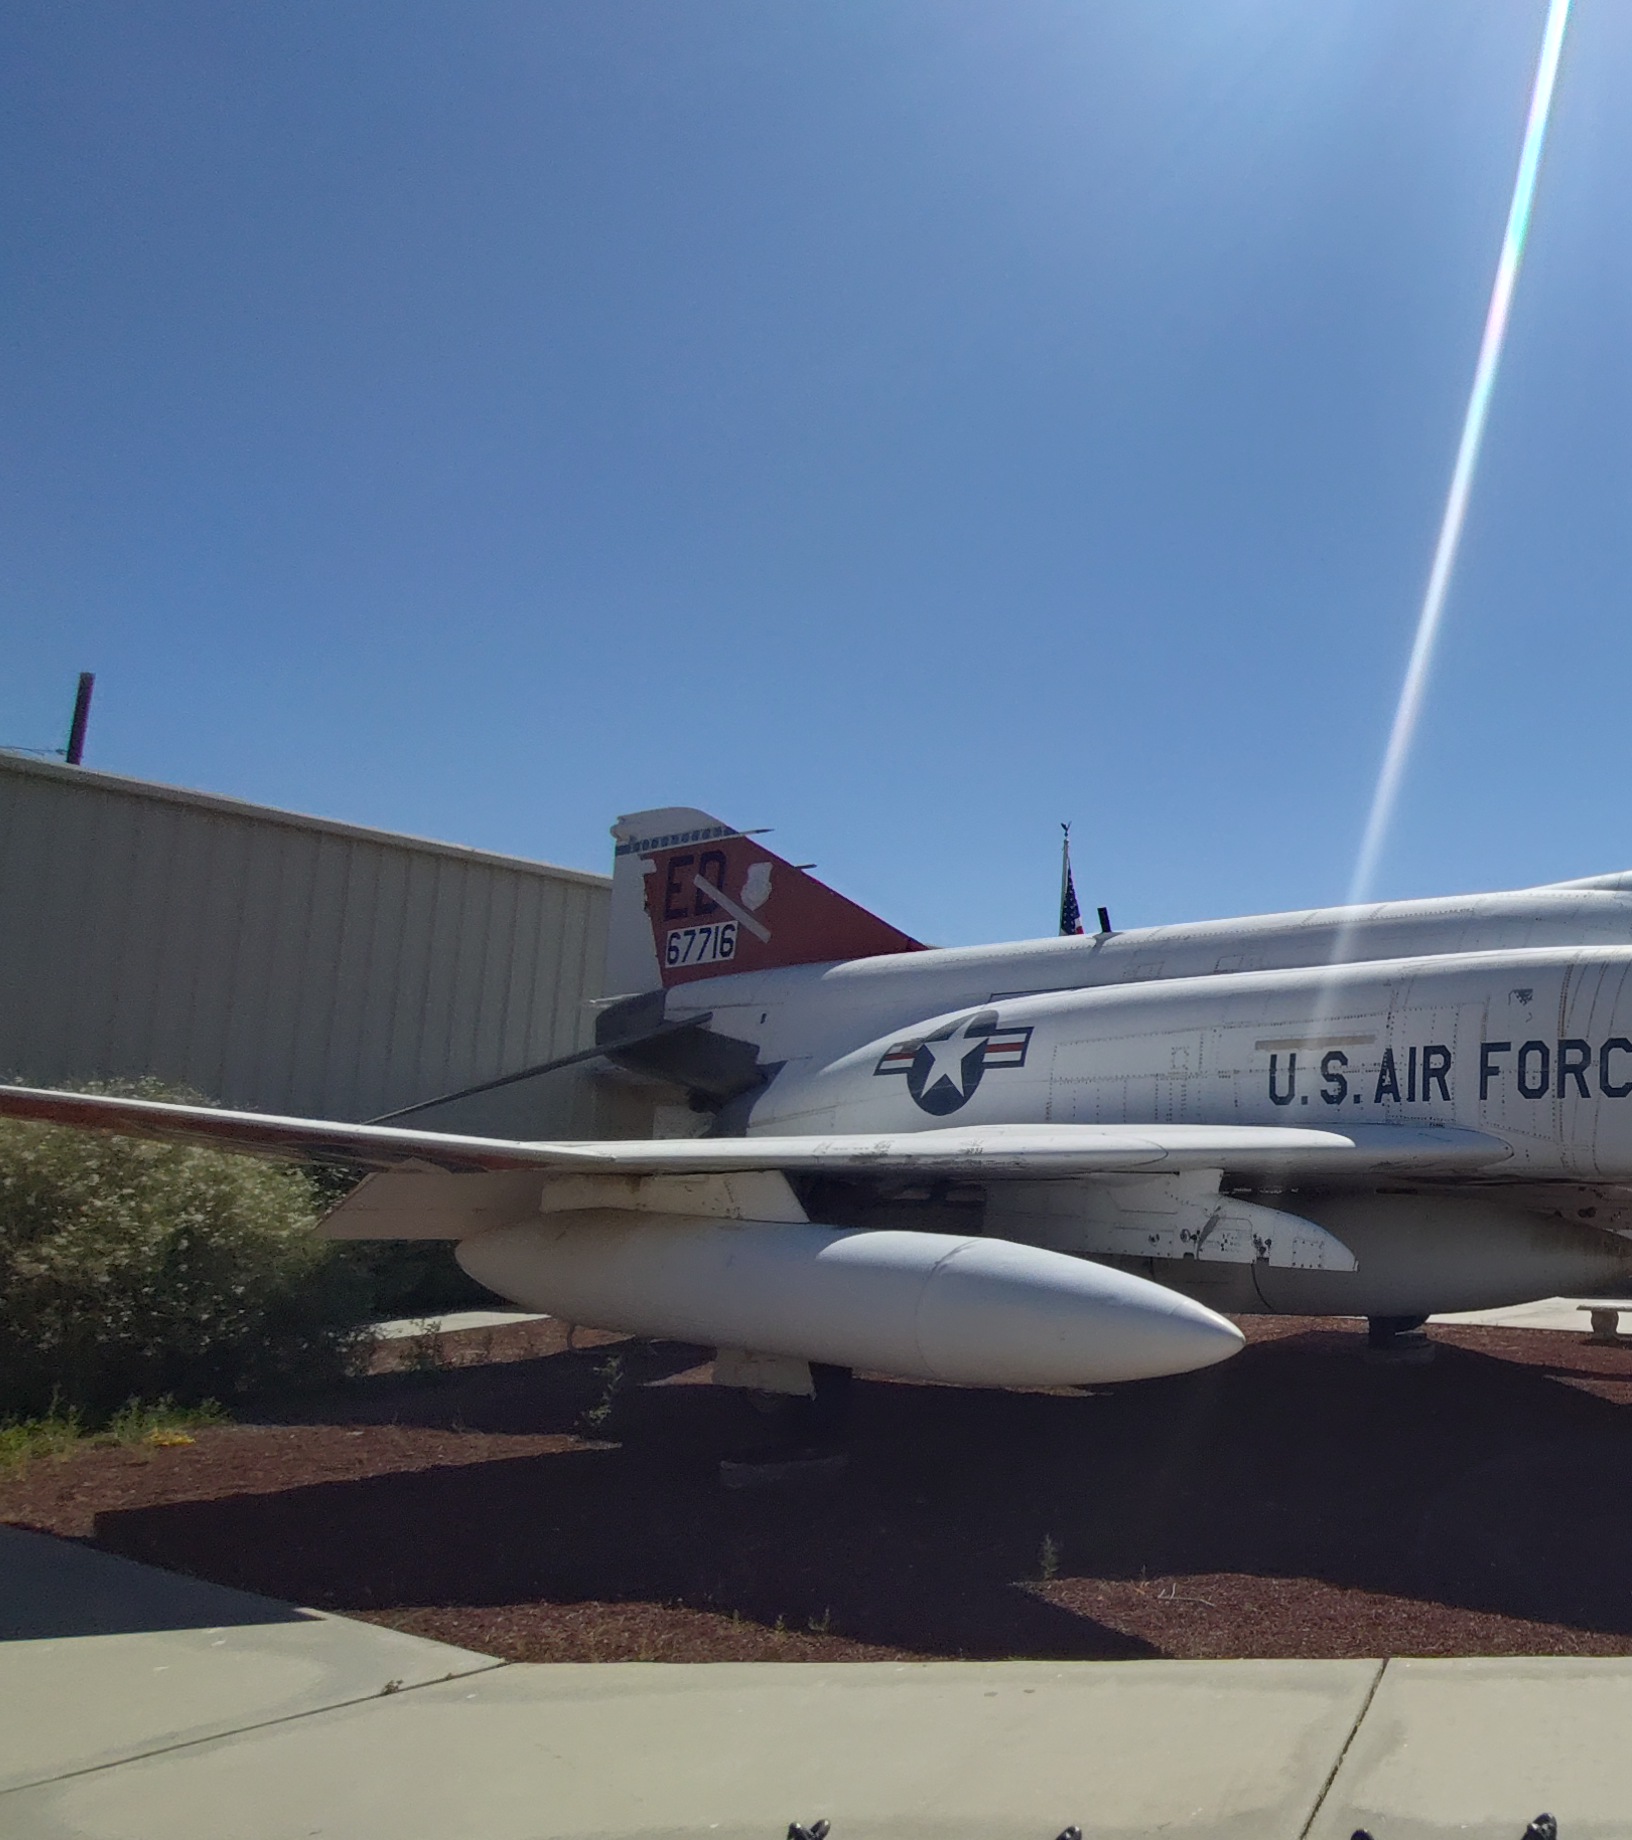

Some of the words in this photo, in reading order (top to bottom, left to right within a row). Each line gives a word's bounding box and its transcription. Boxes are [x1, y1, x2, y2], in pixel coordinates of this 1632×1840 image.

[664, 849, 727, 921] ED
[666, 924, 736, 965] 67716
[1268, 1050, 1361, 1106] U.S.
[1374, 1044, 1452, 1104] AIR
